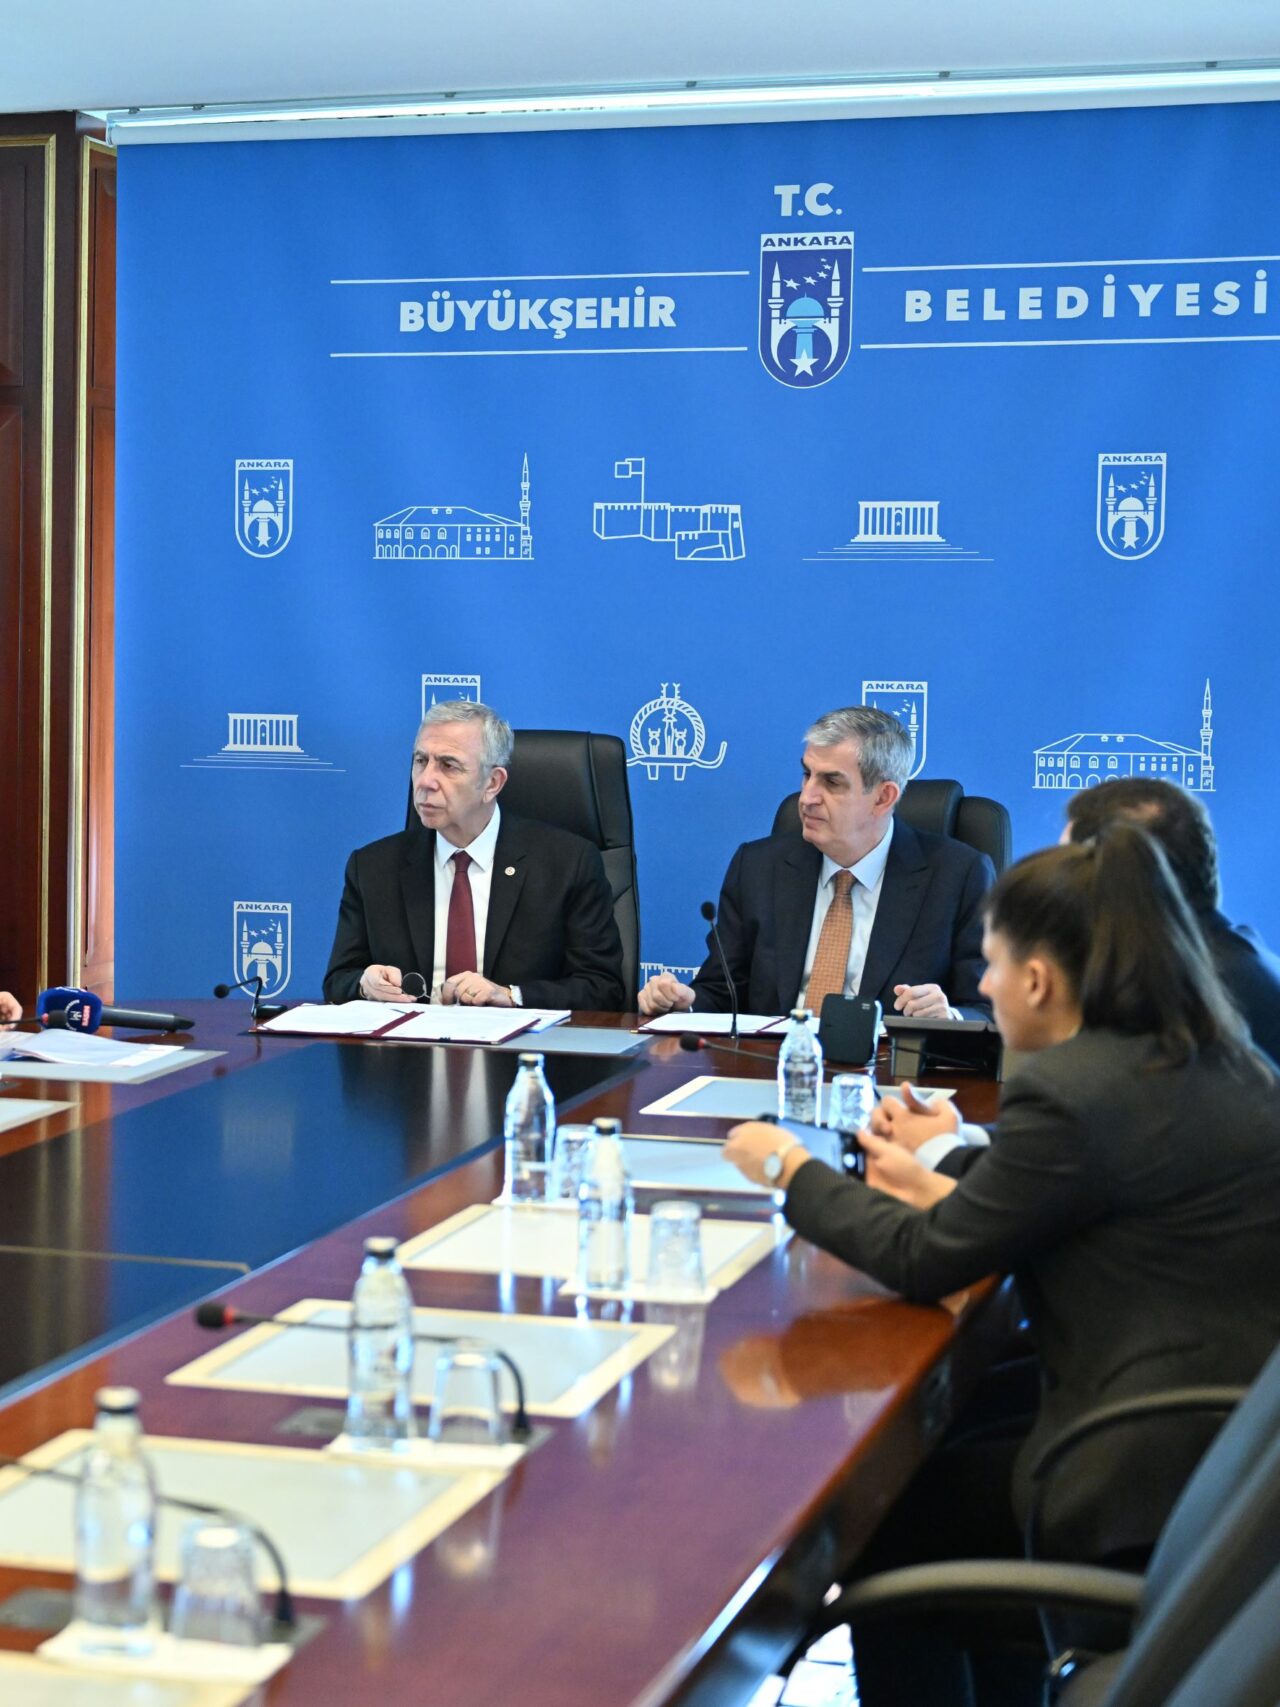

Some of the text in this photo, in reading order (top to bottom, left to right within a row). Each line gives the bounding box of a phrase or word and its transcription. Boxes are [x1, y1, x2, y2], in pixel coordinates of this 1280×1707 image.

[773, 182, 843, 217] T.C.
[762, 235, 852, 247] ANKARA
[905, 269, 1268, 322] BELEDİYESİ
[399, 286, 676, 339] BÜYÜKŞEHİR
[1102, 455, 1163, 463] ANKARA
[425, 676, 478, 684] ANKARA
[865, 682, 924, 690] ANKARA
[236, 903, 289, 911] ANKARA
